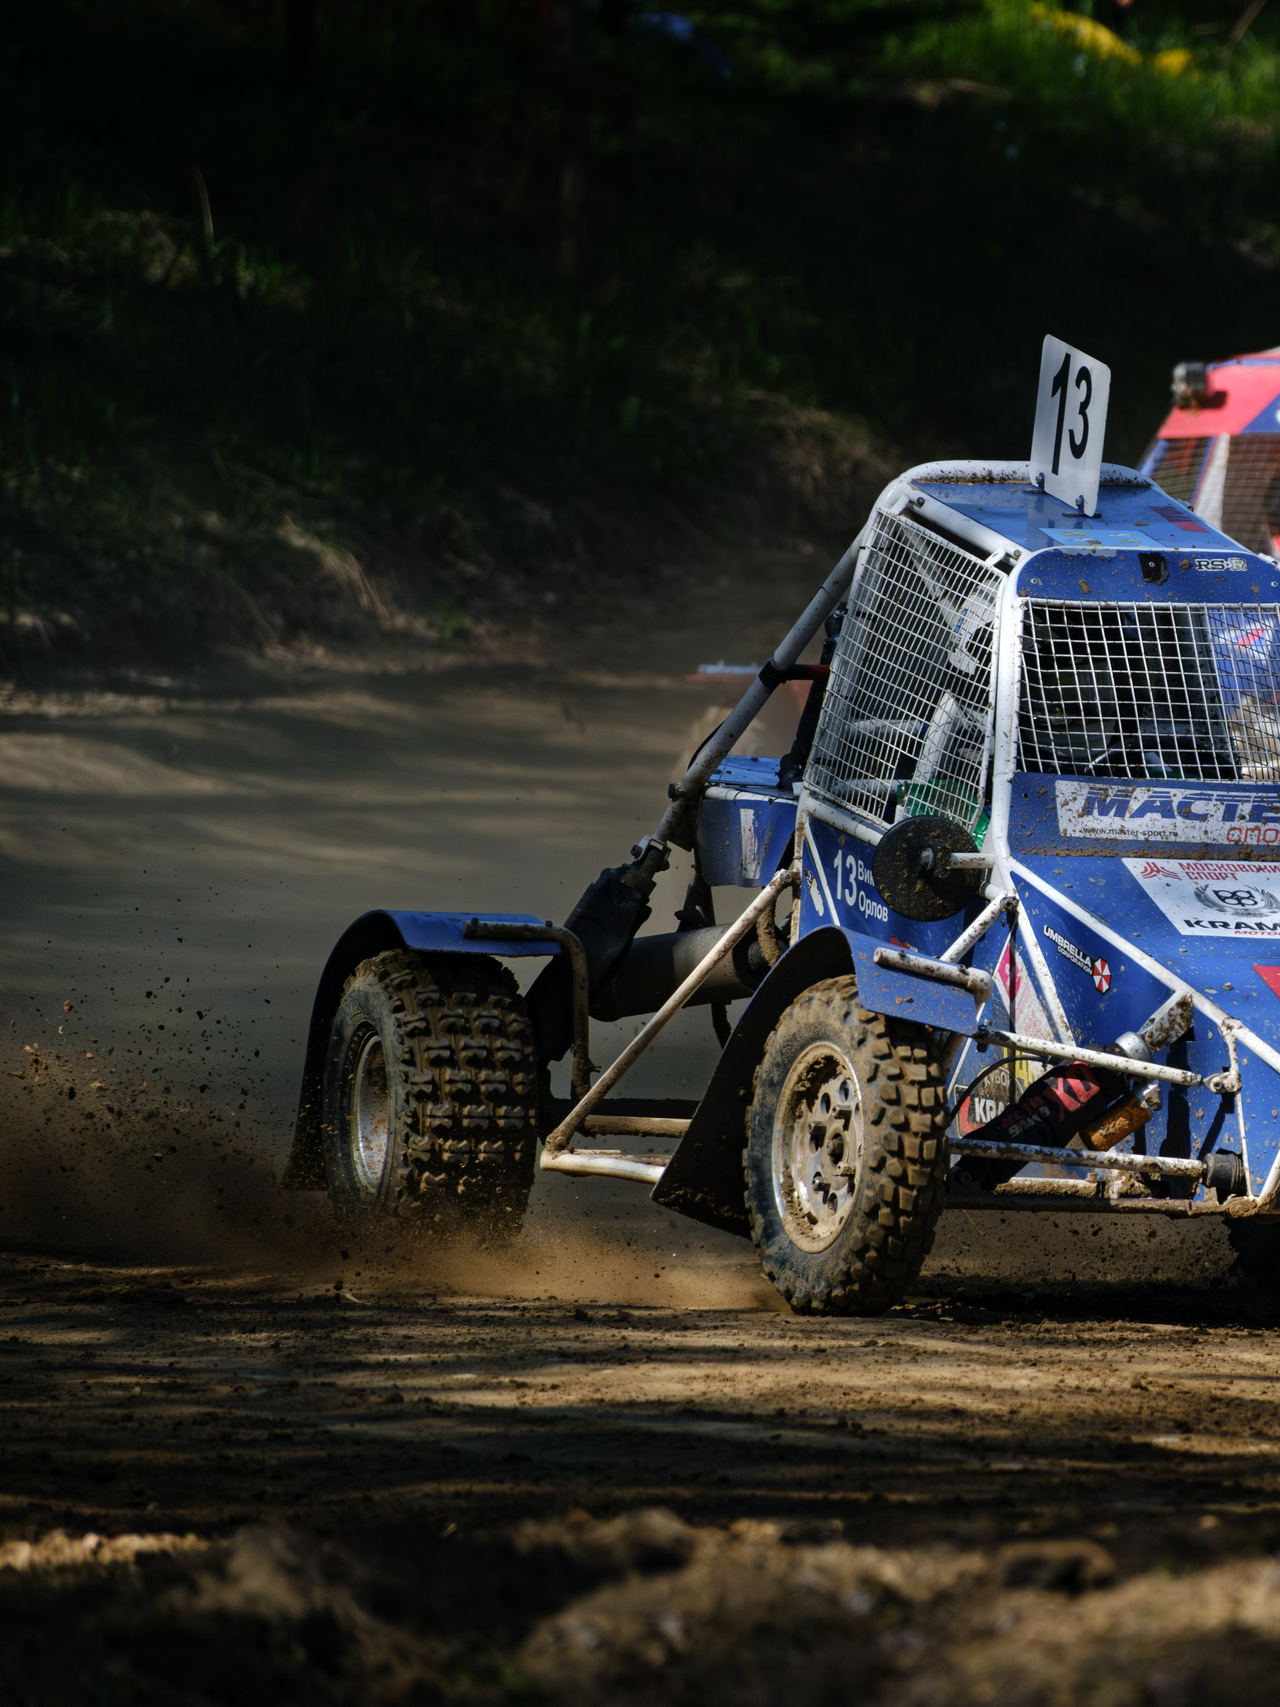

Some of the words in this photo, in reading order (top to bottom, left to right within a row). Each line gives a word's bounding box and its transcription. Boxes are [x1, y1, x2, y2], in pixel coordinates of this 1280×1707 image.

[1051, 352, 1092, 476] 13
[833, 849, 858, 906] 13
[857, 859, 875, 887] Вик
[1184, 871, 1239, 881] СПОРТ
[858, 891, 889, 922] Орлов
[1043, 924, 1092, 968] UMBRELLA
[1057, 945, 1093, 975] CORPORATION
